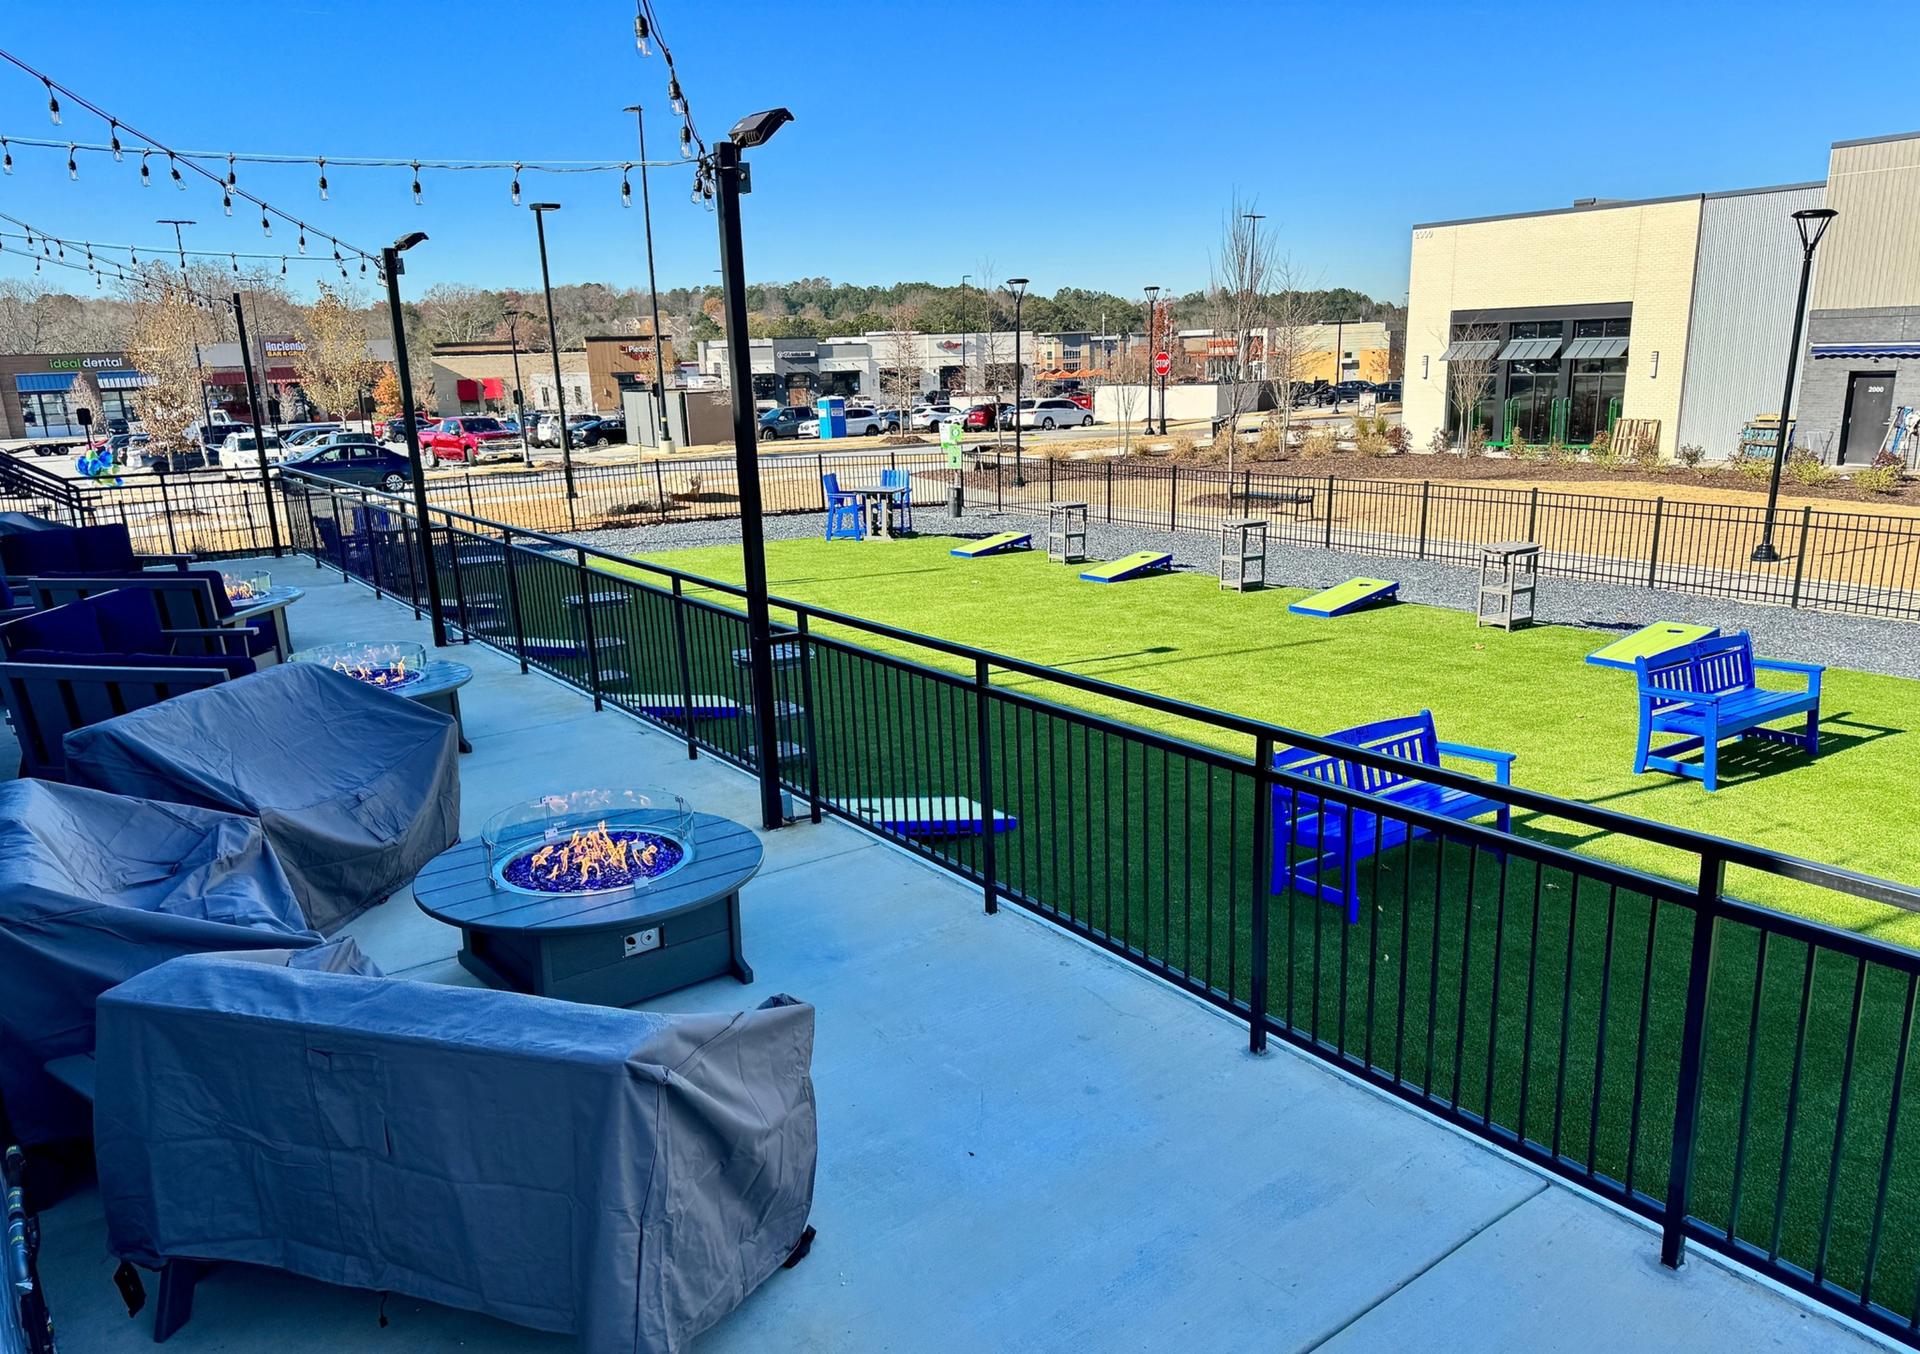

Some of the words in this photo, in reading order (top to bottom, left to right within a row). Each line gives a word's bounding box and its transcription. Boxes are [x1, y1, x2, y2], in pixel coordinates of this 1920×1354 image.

[628, 345, 657, 353] Piedmon
[49, 359, 81, 369] ideal
[82, 358, 123, 368] dental
[1156, 359, 1169, 368] STOP
